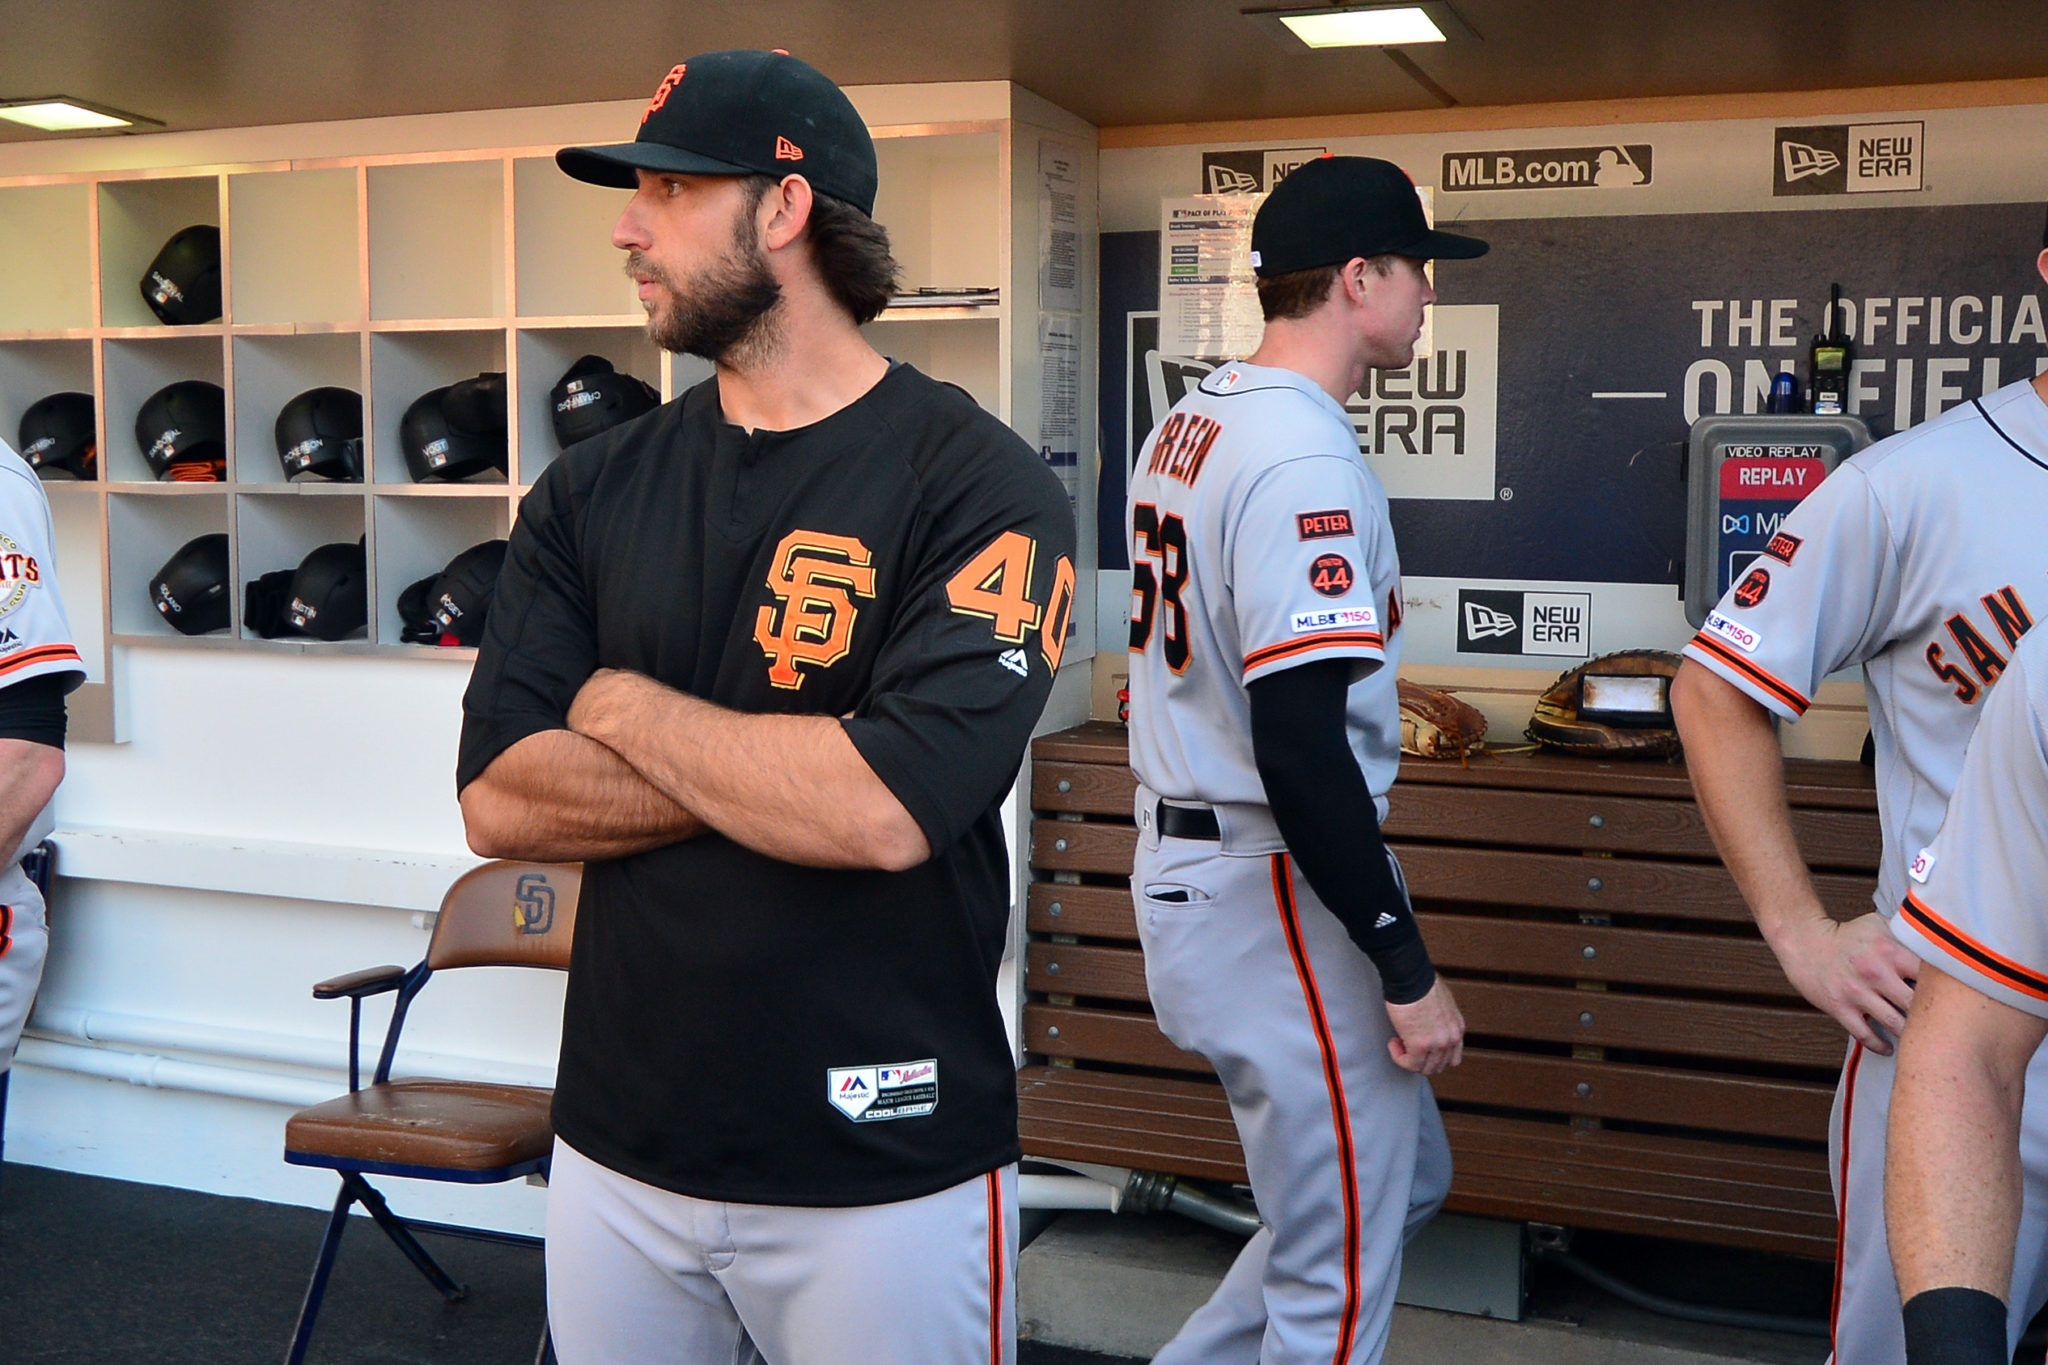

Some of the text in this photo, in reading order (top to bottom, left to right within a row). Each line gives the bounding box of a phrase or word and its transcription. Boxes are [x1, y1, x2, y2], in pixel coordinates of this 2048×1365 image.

[1859, 137, 1912, 157] NEW
[1450, 157, 1589, 186] MLB.com
[1859, 157, 1911, 177] ERA
[1692, 300, 1797, 347] THE
[1728, 446, 1818, 457] VIDEO REPLAY
[1740, 467, 1807, 486] REPLAY
[1303, 514, 1349, 534] PETER
[1313, 567, 1350, 591] 44
[1736, 581, 1763, 605] 44
[946, 530, 1076, 678] 40
[1297, 615, 1330, 628] MLB
[1533, 606, 1581, 624] NEW
[1533, 624, 1580, 643] ERA
[1926, 584, 2036, 704] SAN
[840, 1092, 869, 1100] Majestic
